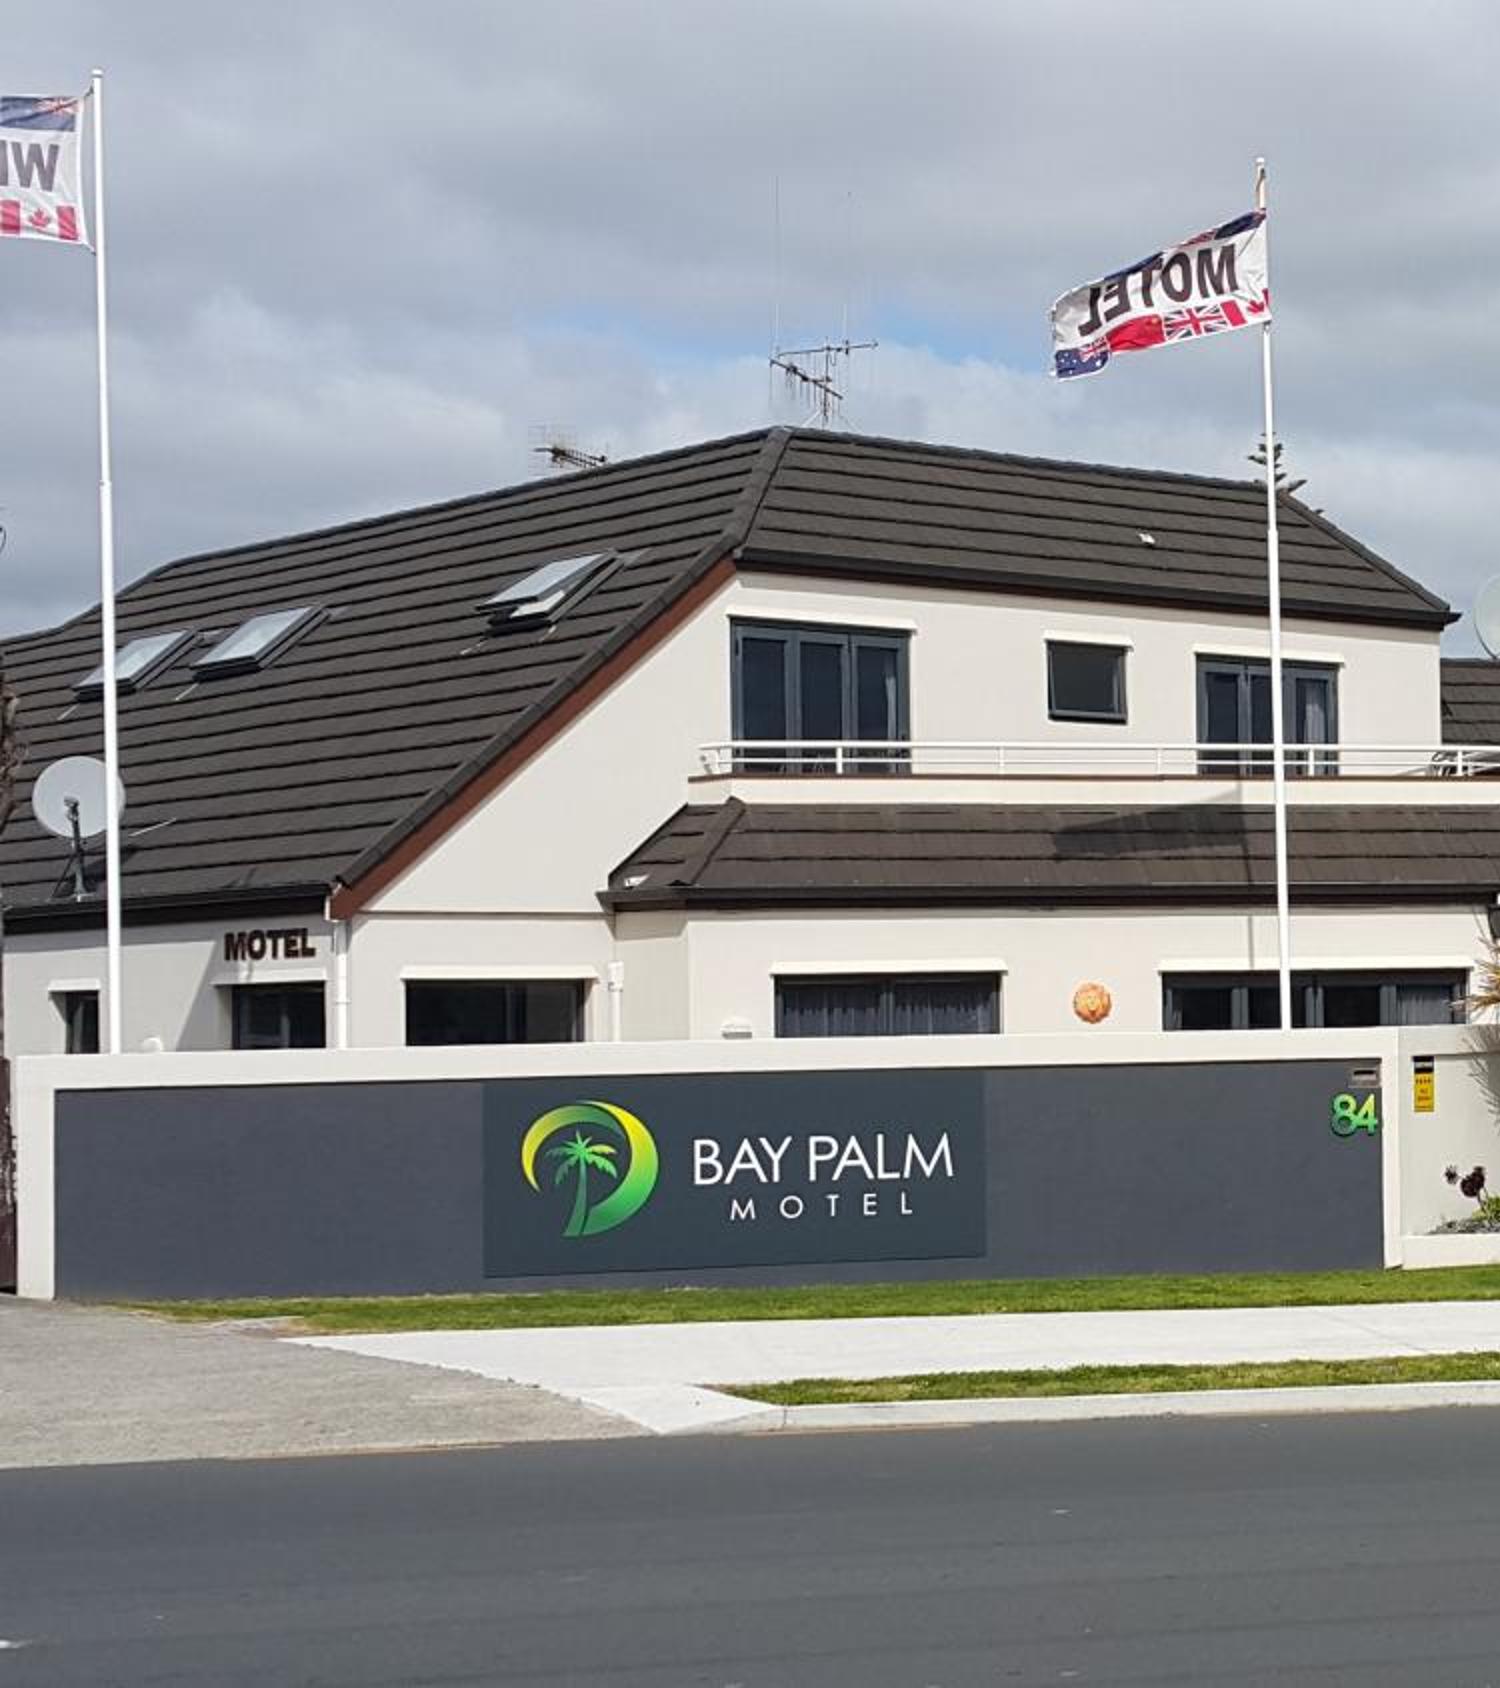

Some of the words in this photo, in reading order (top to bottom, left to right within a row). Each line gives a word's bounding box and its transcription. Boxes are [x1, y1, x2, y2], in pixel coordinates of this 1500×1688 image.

[224, 928, 316, 961] MOTEL
[1332, 1093, 1378, 1136] 84
[693, 1136, 793, 1185] BAY
[808, 1132, 955, 1182] PALM
[729, 1191, 913, 1221] MOTEL
